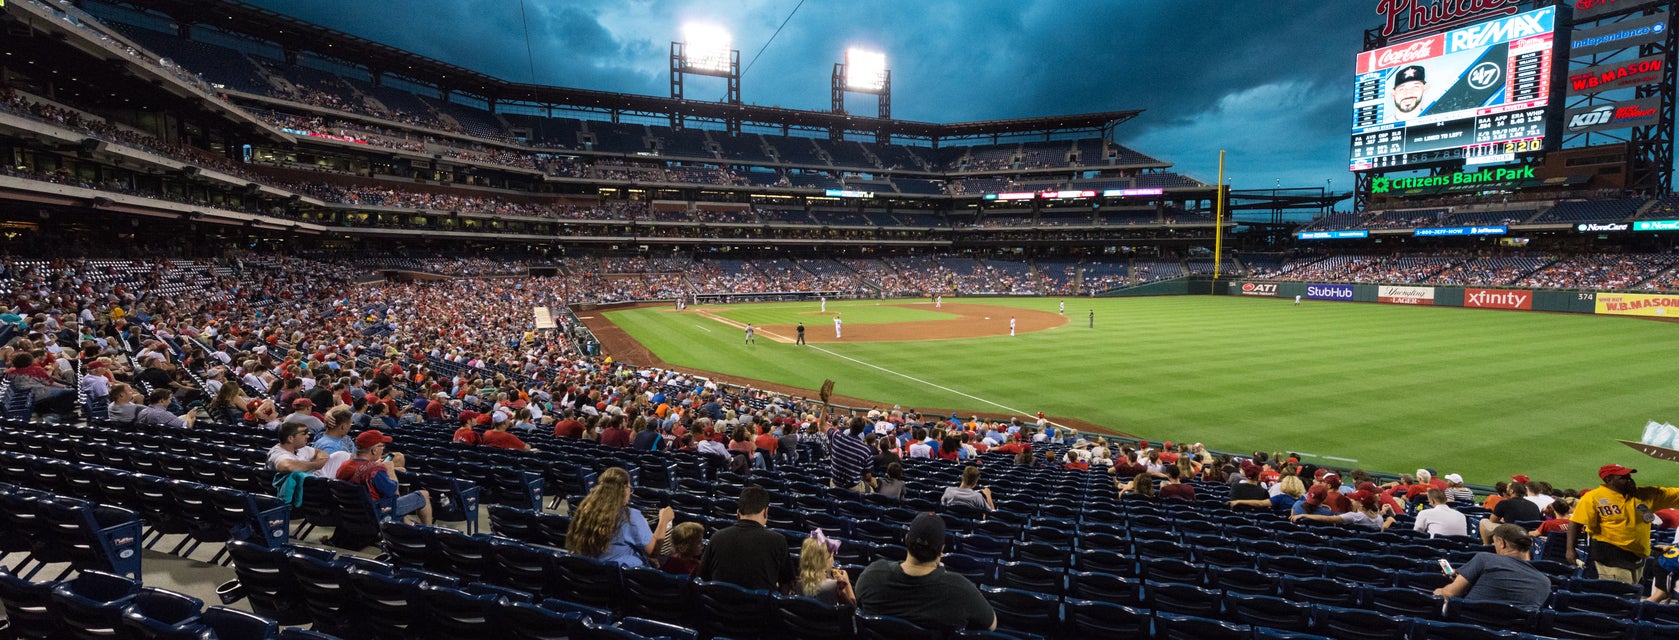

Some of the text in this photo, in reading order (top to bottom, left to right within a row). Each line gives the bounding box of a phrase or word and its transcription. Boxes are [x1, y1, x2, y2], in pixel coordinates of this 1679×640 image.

[1452, 12, 1546, 51] RE/MAX
[1572, 27, 1650, 48] Independence
[1378, 39, 1435, 67] Coca-Cola
[1505, 143, 1515, 153] 2
[1517, 141, 1528, 152] 2
[1530, 140, 1540, 150] 0
[1392, 165, 1535, 189] Citizens Bank Park
[1587, 223, 1628, 231] NovaCare
[1253, 284, 1277, 292] ATI
[1307, 286, 1353, 298] StubHub
[1468, 290, 1528, 308] xfinity
